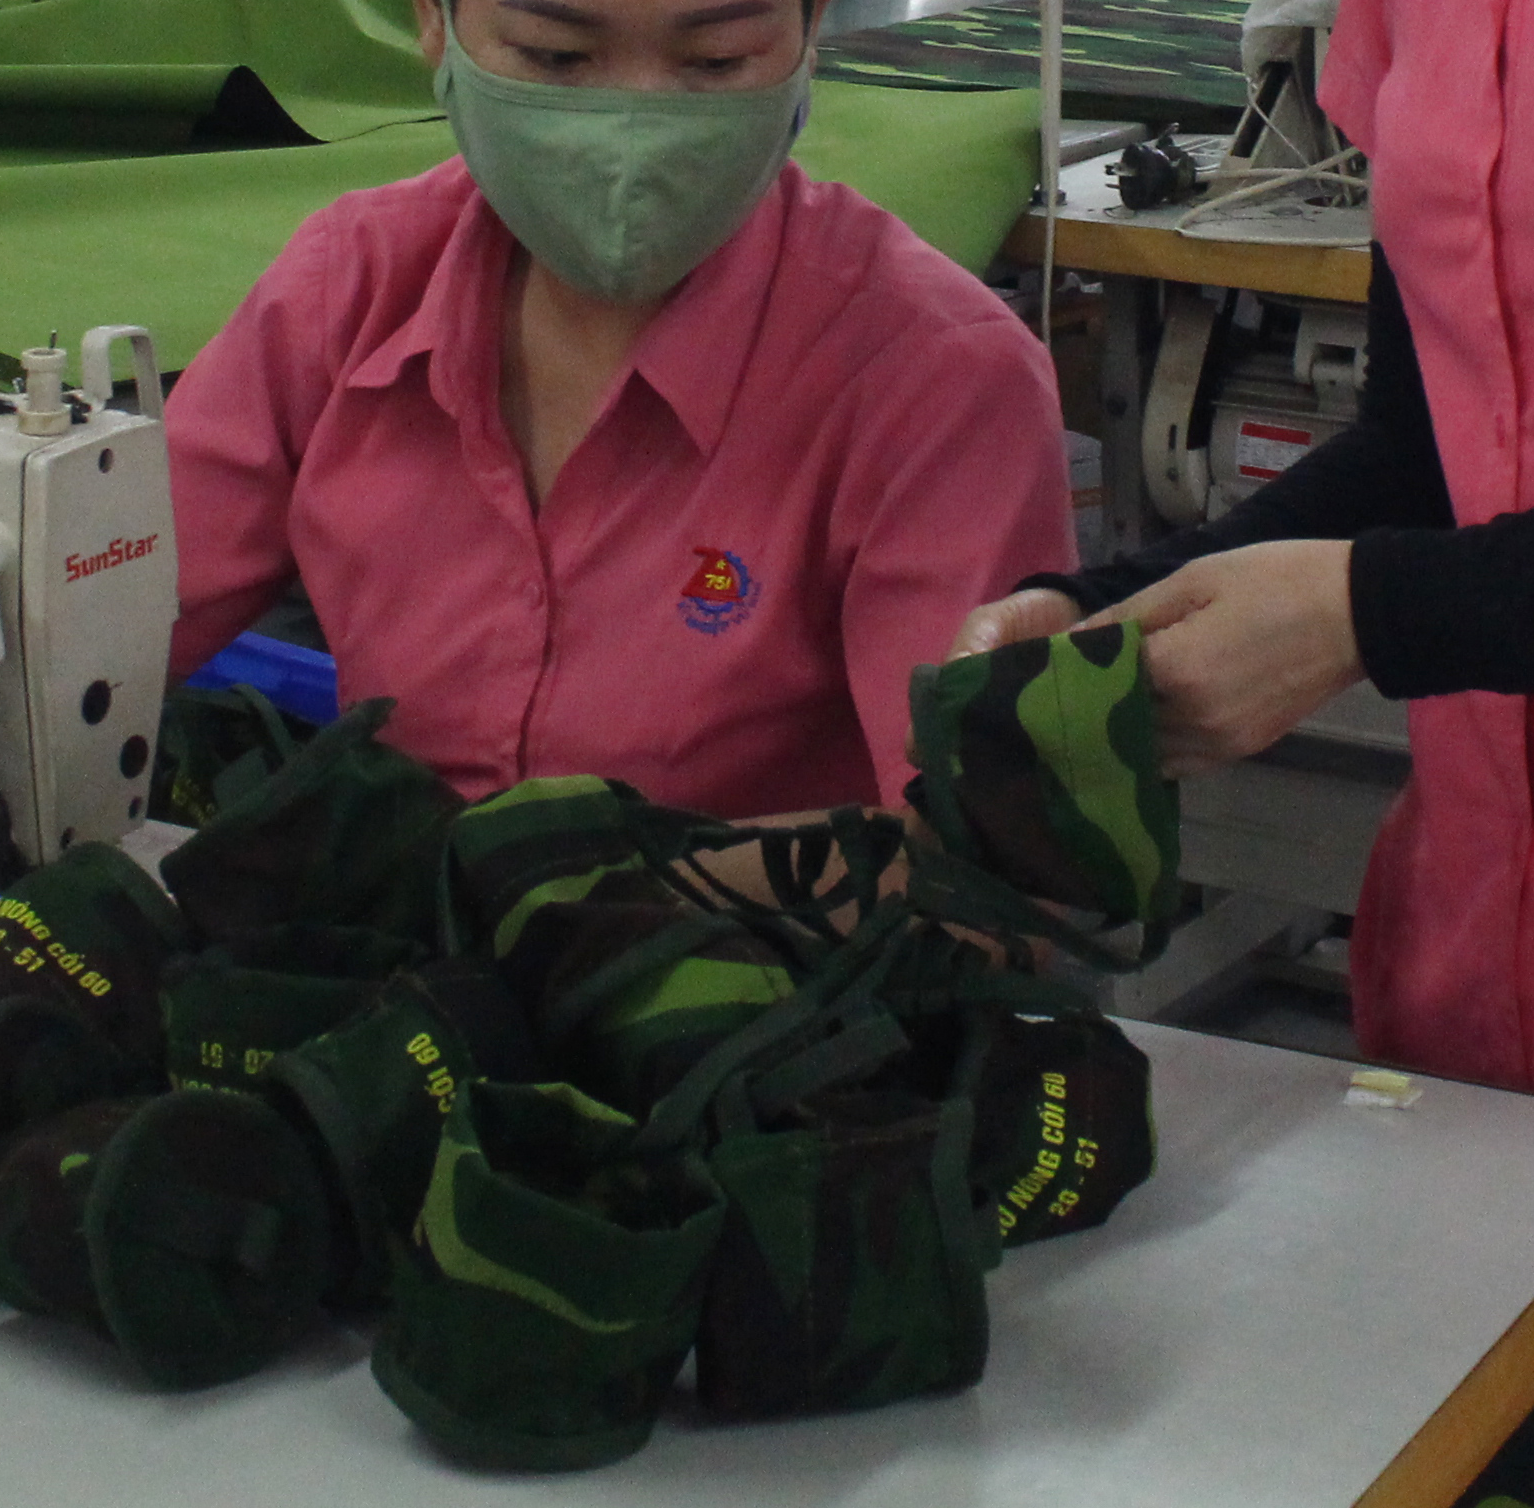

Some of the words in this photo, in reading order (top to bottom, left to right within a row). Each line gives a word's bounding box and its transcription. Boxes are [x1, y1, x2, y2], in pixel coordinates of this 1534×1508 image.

[65, 533, 159, 582] SunStar
[12, 946, 47, 973] 51
[78, 970, 114, 998] 60
[1041, 1072, 1067, 1100] 60
